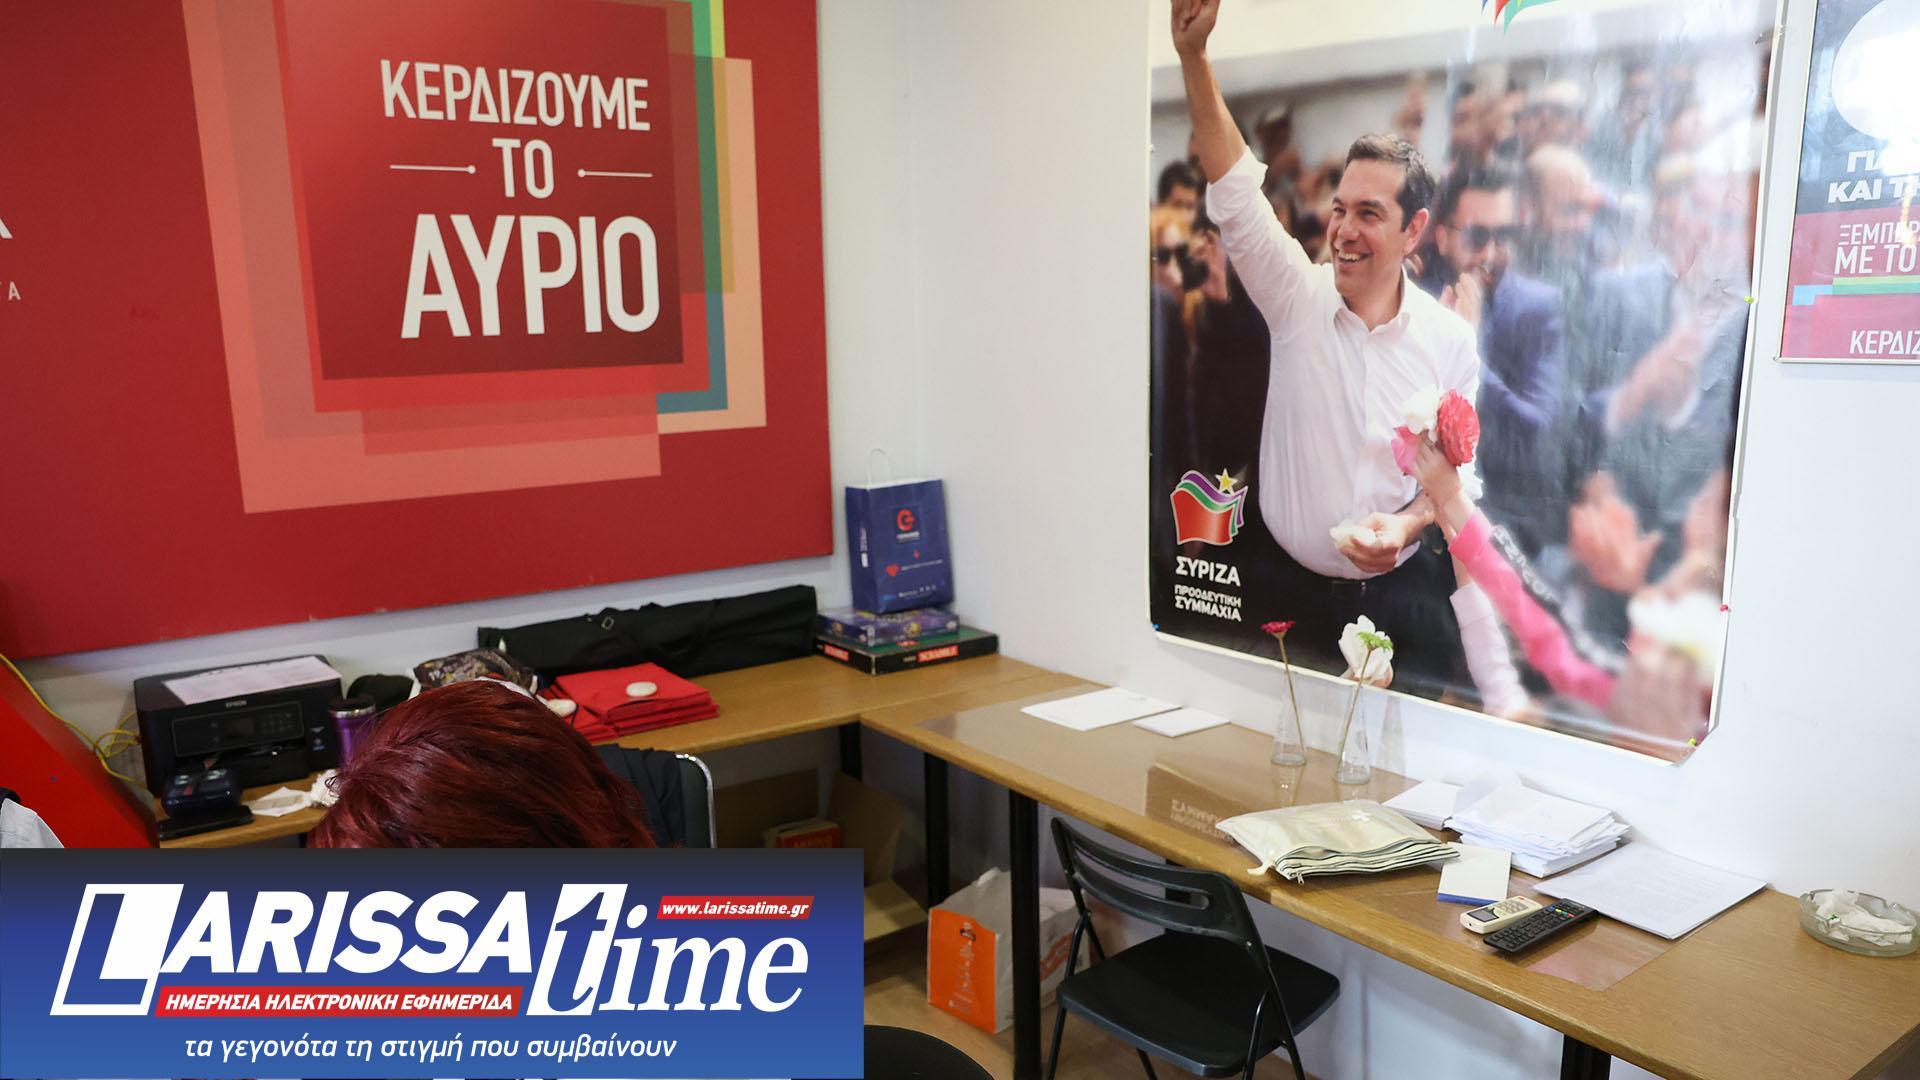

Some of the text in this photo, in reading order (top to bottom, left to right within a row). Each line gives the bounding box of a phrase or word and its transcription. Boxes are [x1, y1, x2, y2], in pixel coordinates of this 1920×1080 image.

[380, 59, 651, 131] ΚΕΡΔΙΖΟΥΜΕ
[492, 138, 554, 199] ΤΟ
[1828, 178, 1882, 203] ΚΑΙ
[1838, 220, 1920, 245] ΞΕΜΠΕΡ
[1834, 243, 1917, 274] ΜΕ ΤΟ
[401, 213, 660, 339] ΑΥΡΙΟ
[1175, 555, 1241, 587] ΣΥΡΙΖΑ
[1174, 584, 1242, 608] ΠΡΟΟΔΕΥΤΙΚΗ
[1175, 595, 1242, 622] ΣΥΜΜΑΧΙΑ
